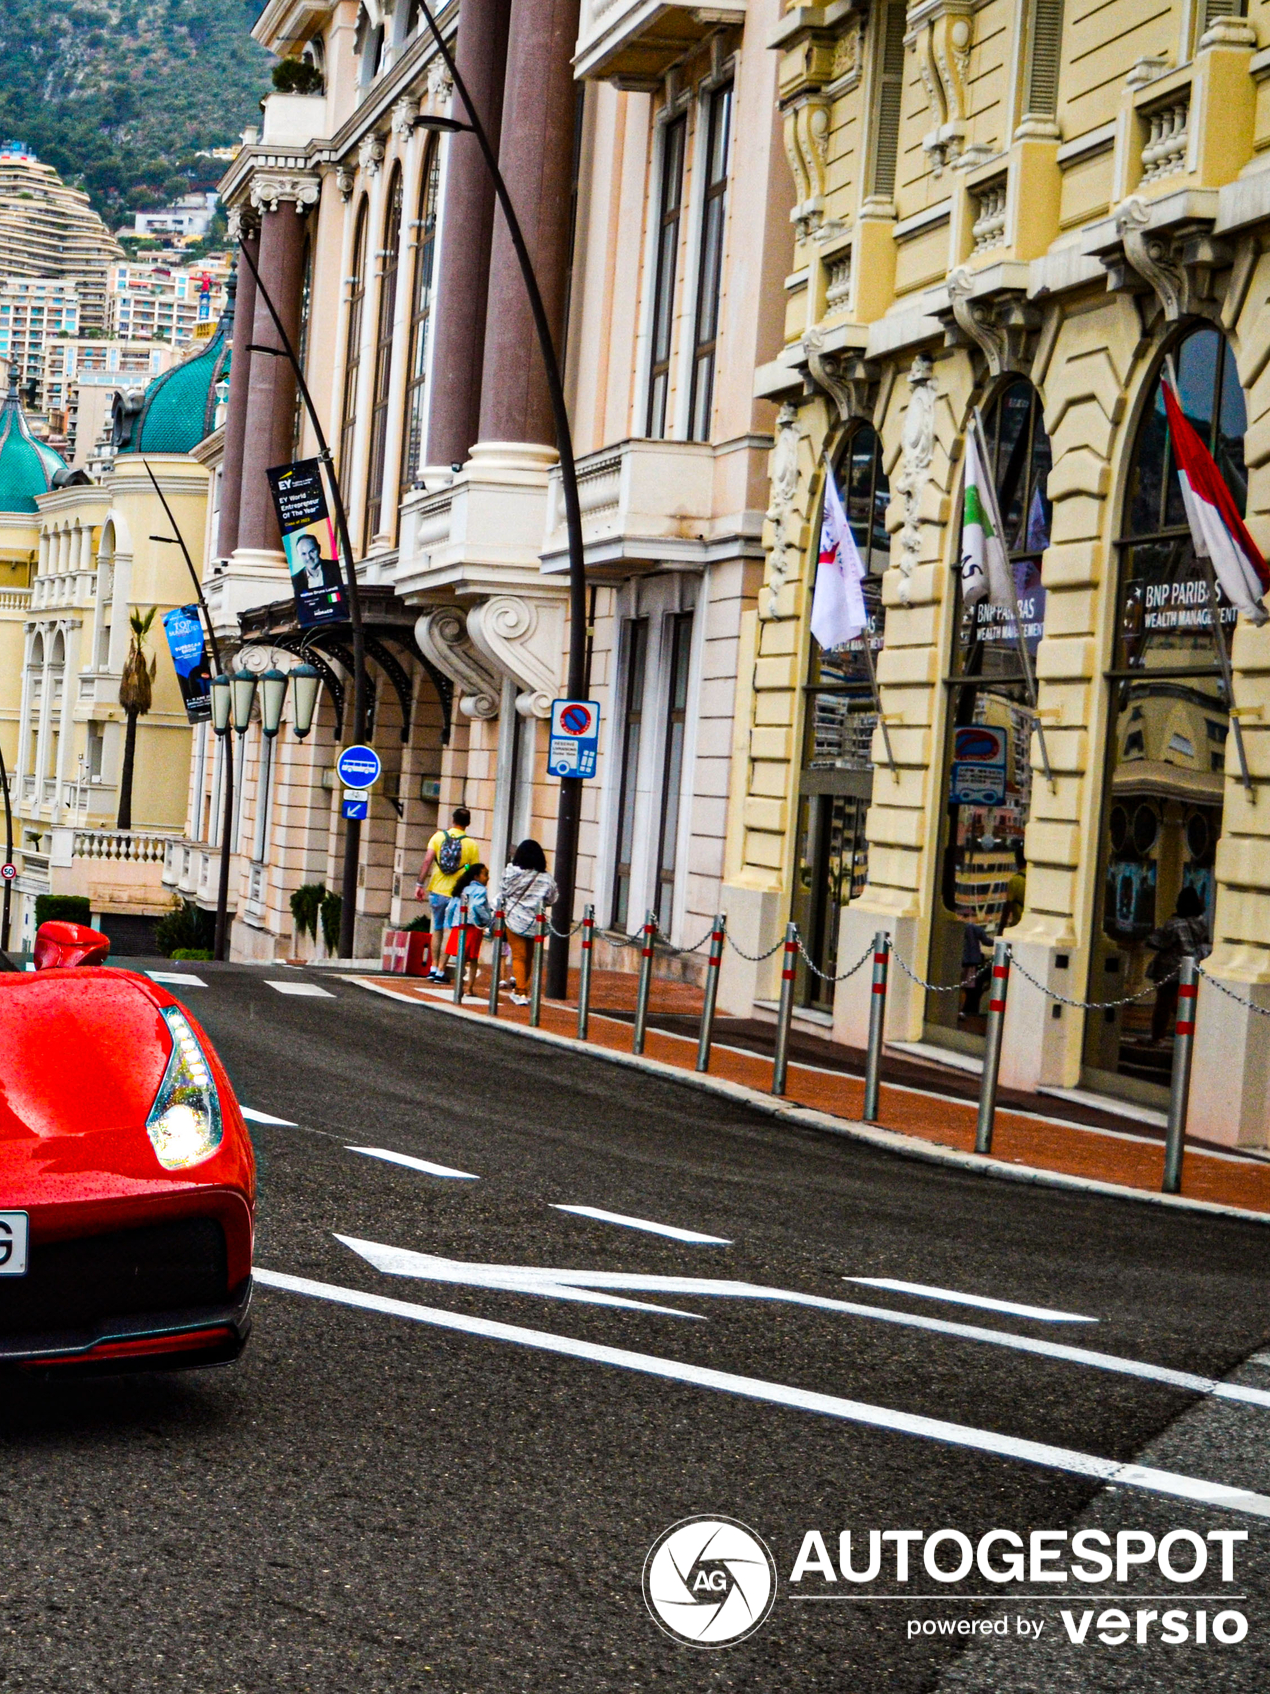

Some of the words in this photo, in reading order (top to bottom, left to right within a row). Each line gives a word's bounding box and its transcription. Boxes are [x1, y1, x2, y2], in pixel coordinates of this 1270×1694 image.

[278, 479, 292, 491] EY
[289, 492, 307, 502] World
[281, 499, 320, 512] Entrepreneur
[282, 511, 291, 519] Of
[291, 509, 303, 517] The
[1145, 583, 1170, 608] BNP
[1171, 579, 1222, 606] PARIBS
[173, 620, 191, 630] TOP
[1144, 611, 1177, 629] WEALTH
[4, 868, 14, 876] 50
